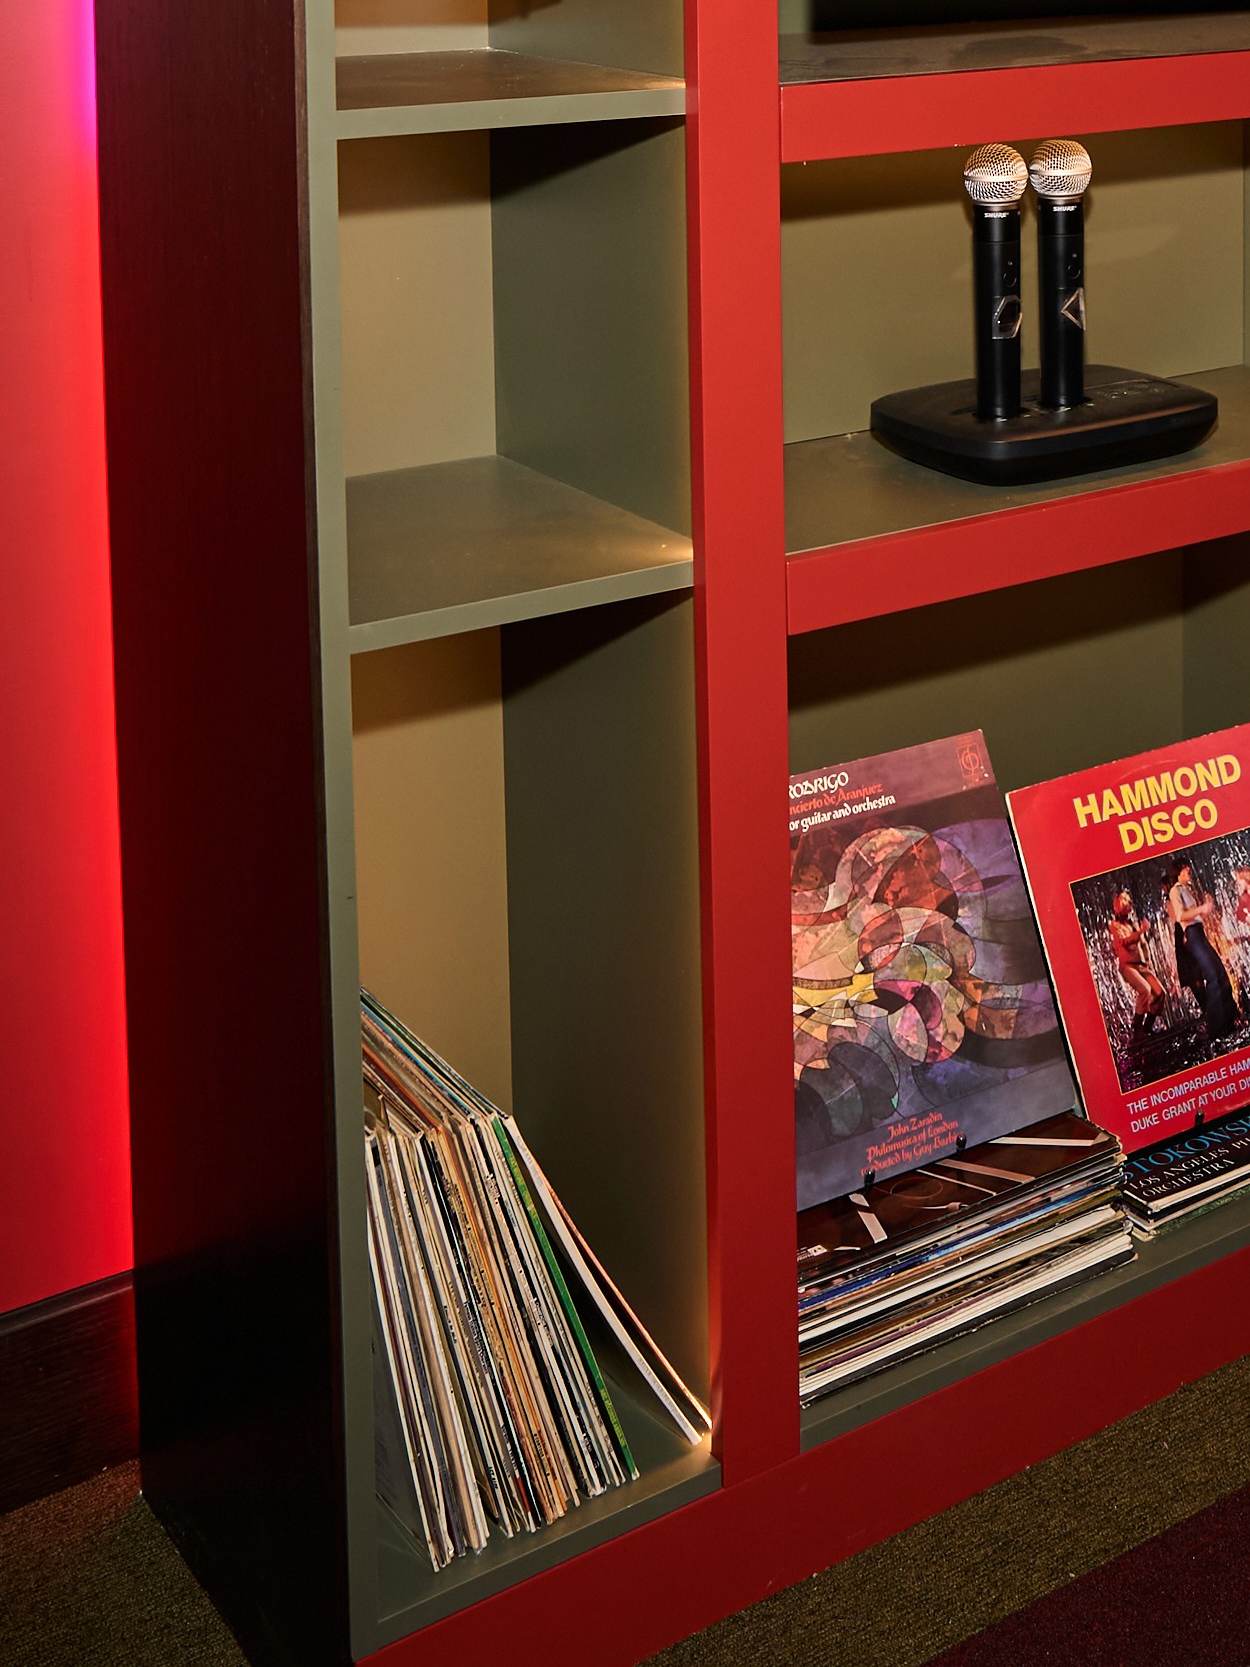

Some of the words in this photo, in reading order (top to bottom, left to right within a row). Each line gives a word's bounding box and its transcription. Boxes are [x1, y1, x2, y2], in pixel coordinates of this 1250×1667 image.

[789, 796, 823, 814] ncierto
[823, 792, 836, 805] de
[835, 784, 883, 806] Aranjuez
[1073, 754, 1242, 829] HAMMOND
[789, 820, 800, 831] or
[800, 810, 832, 832] guitar
[832, 803, 851, 819] and
[852, 795, 896, 814] orchestra
[1118, 799, 1218, 854] DISCO
[1127, 1097, 1149, 1115] THE
[1150, 1067, 1227, 1107] INCOMPARABLE
[1130, 1114, 1160, 1133] DUKE
[1162, 1099, 1196, 1121] GRANT
[1198, 1094, 1211, 1108] AT
[1210, 1084, 1237, 1102] YOUR
[866, 1135, 918, 1163] Philomusica
[927, 1120, 958, 1138] London
[887, 1123, 909, 1142] John
[901, 1149, 913, 1163] by
[913, 1142, 932, 1160] Guy
[1129, 1175, 1161, 1190] LOS
[1163, 1147, 1230, 1179] ANGELES
[1142, 1158, 1235, 1197] ORCHESTRA
